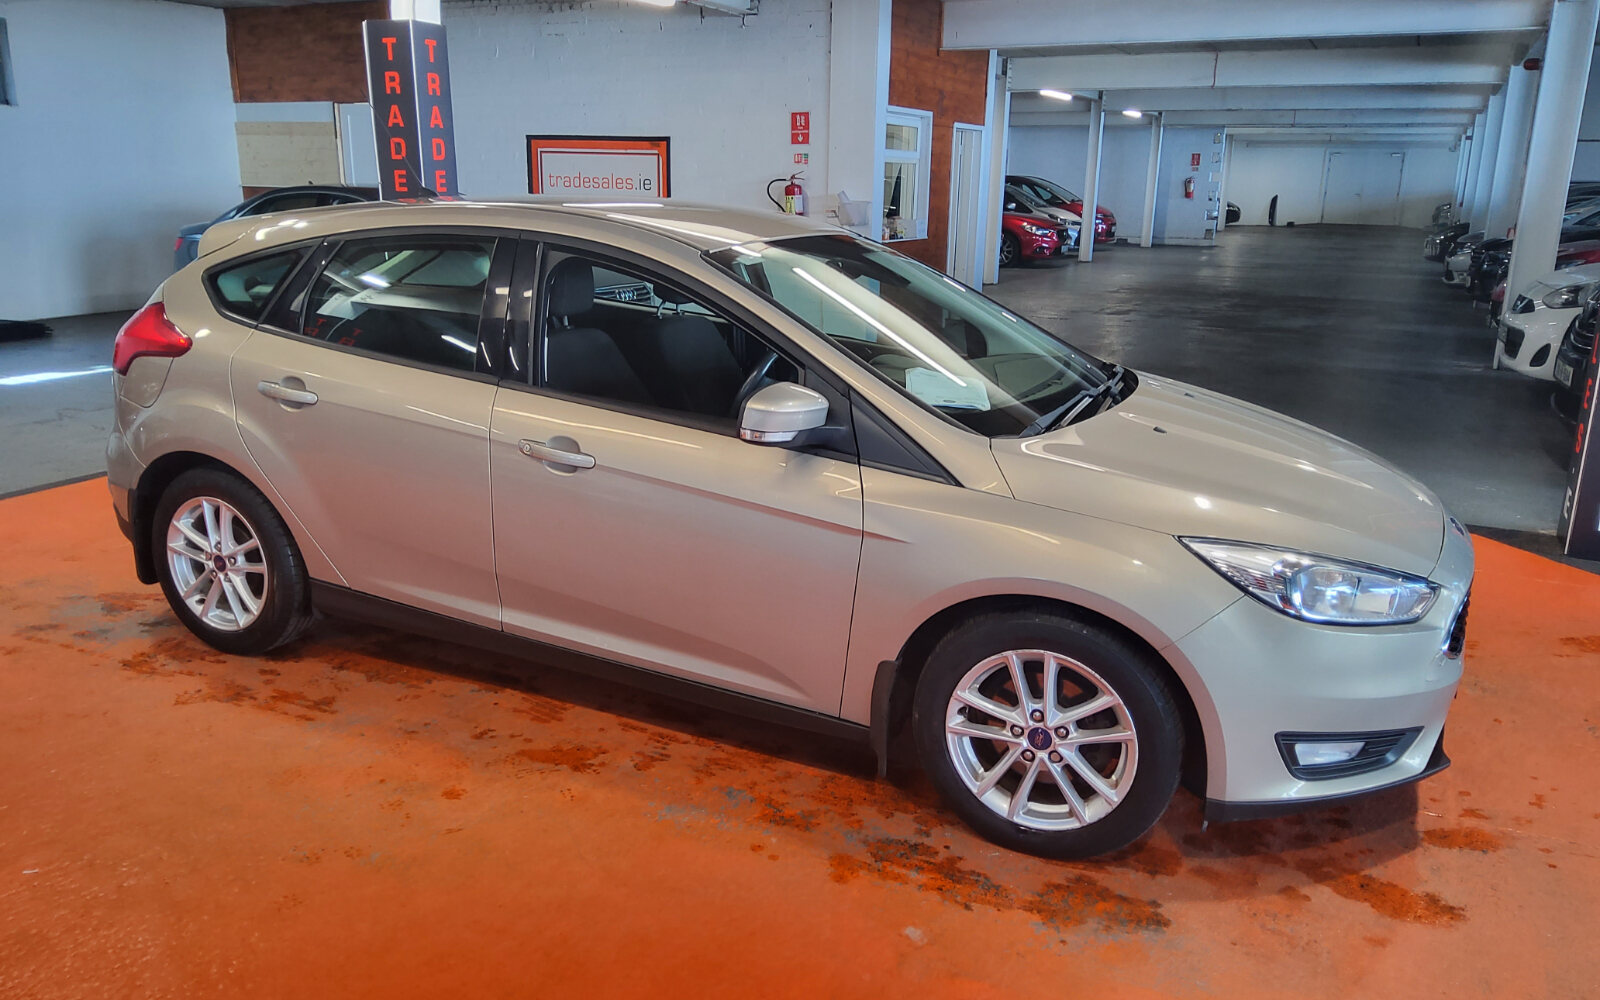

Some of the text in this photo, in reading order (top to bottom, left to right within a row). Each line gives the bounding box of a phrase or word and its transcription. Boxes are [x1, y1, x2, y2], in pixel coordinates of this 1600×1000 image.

[381, 37, 408, 192] TRADE
[424, 39, 447, 192] TRADE
[549, 171, 652, 191] tradesales.ie
